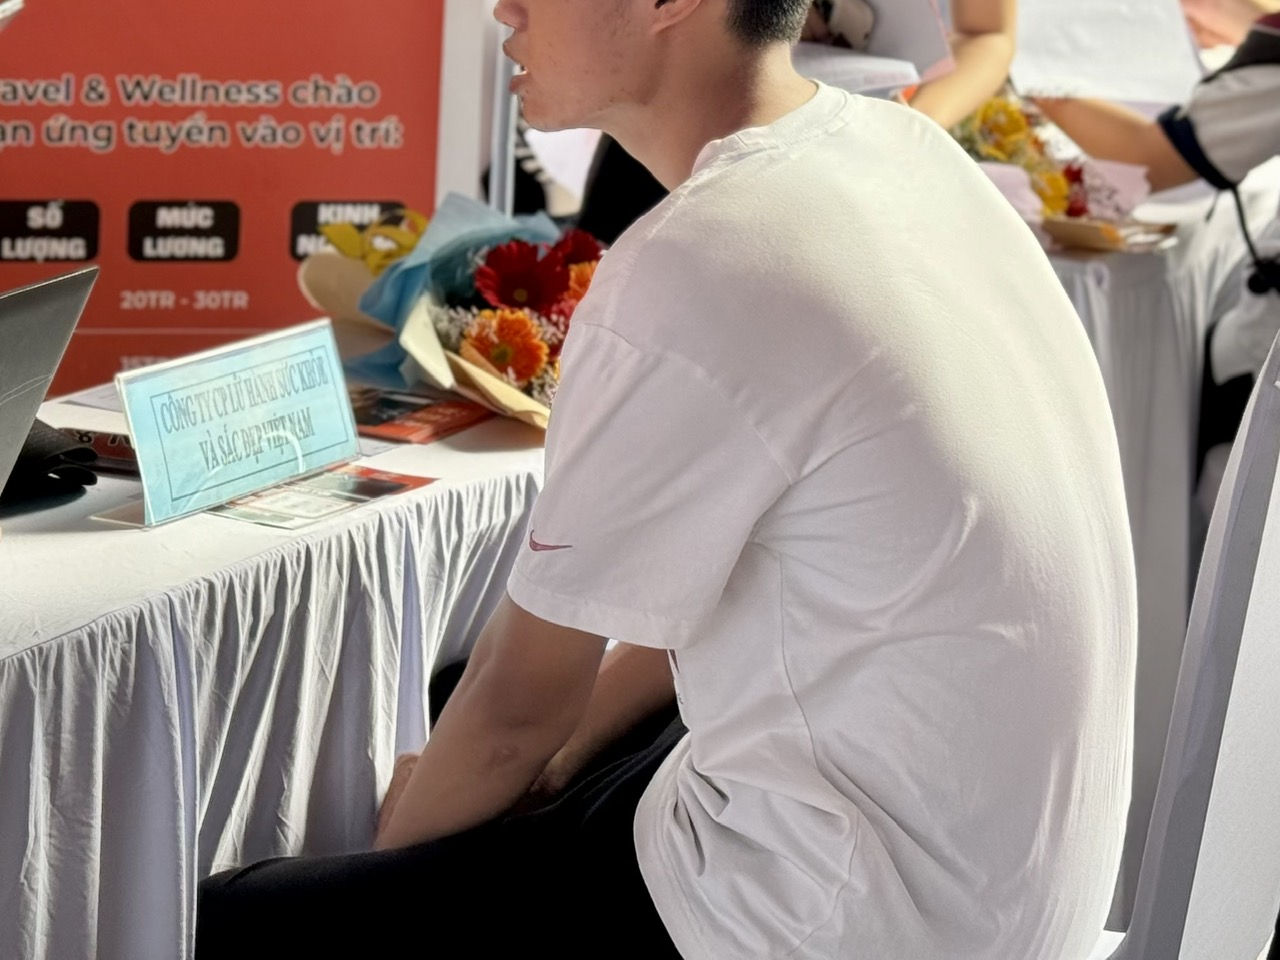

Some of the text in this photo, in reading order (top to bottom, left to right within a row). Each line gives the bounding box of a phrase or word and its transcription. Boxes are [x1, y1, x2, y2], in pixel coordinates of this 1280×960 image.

[82, 75, 109, 106] &
[118, 73, 282, 107] Wellness
[289, 74, 381, 107] chào
[42, 112, 117, 153] ứng
[123, 110, 230, 153] tuyển
[236, 114, 302, 147] vào
[308, 113, 345, 154] vị
[26, 200, 63, 229] SỐ
[156, 202, 214, 229] MỨC
[318, 203, 380, 224] KINH
[0, 235, 87, 263] LƯỢNG
[142, 234, 224, 258] LƯƠNG
[120, 291, 175, 310] 20TR
[193, 291, 249, 310] 30TR
[160, 392, 197, 434] CÔNG
[195, 391, 213, 424] TY
[212, 387, 228, 418] CP
[199, 428, 220, 471] VÀ
[287, 407, 316, 445] NAM
